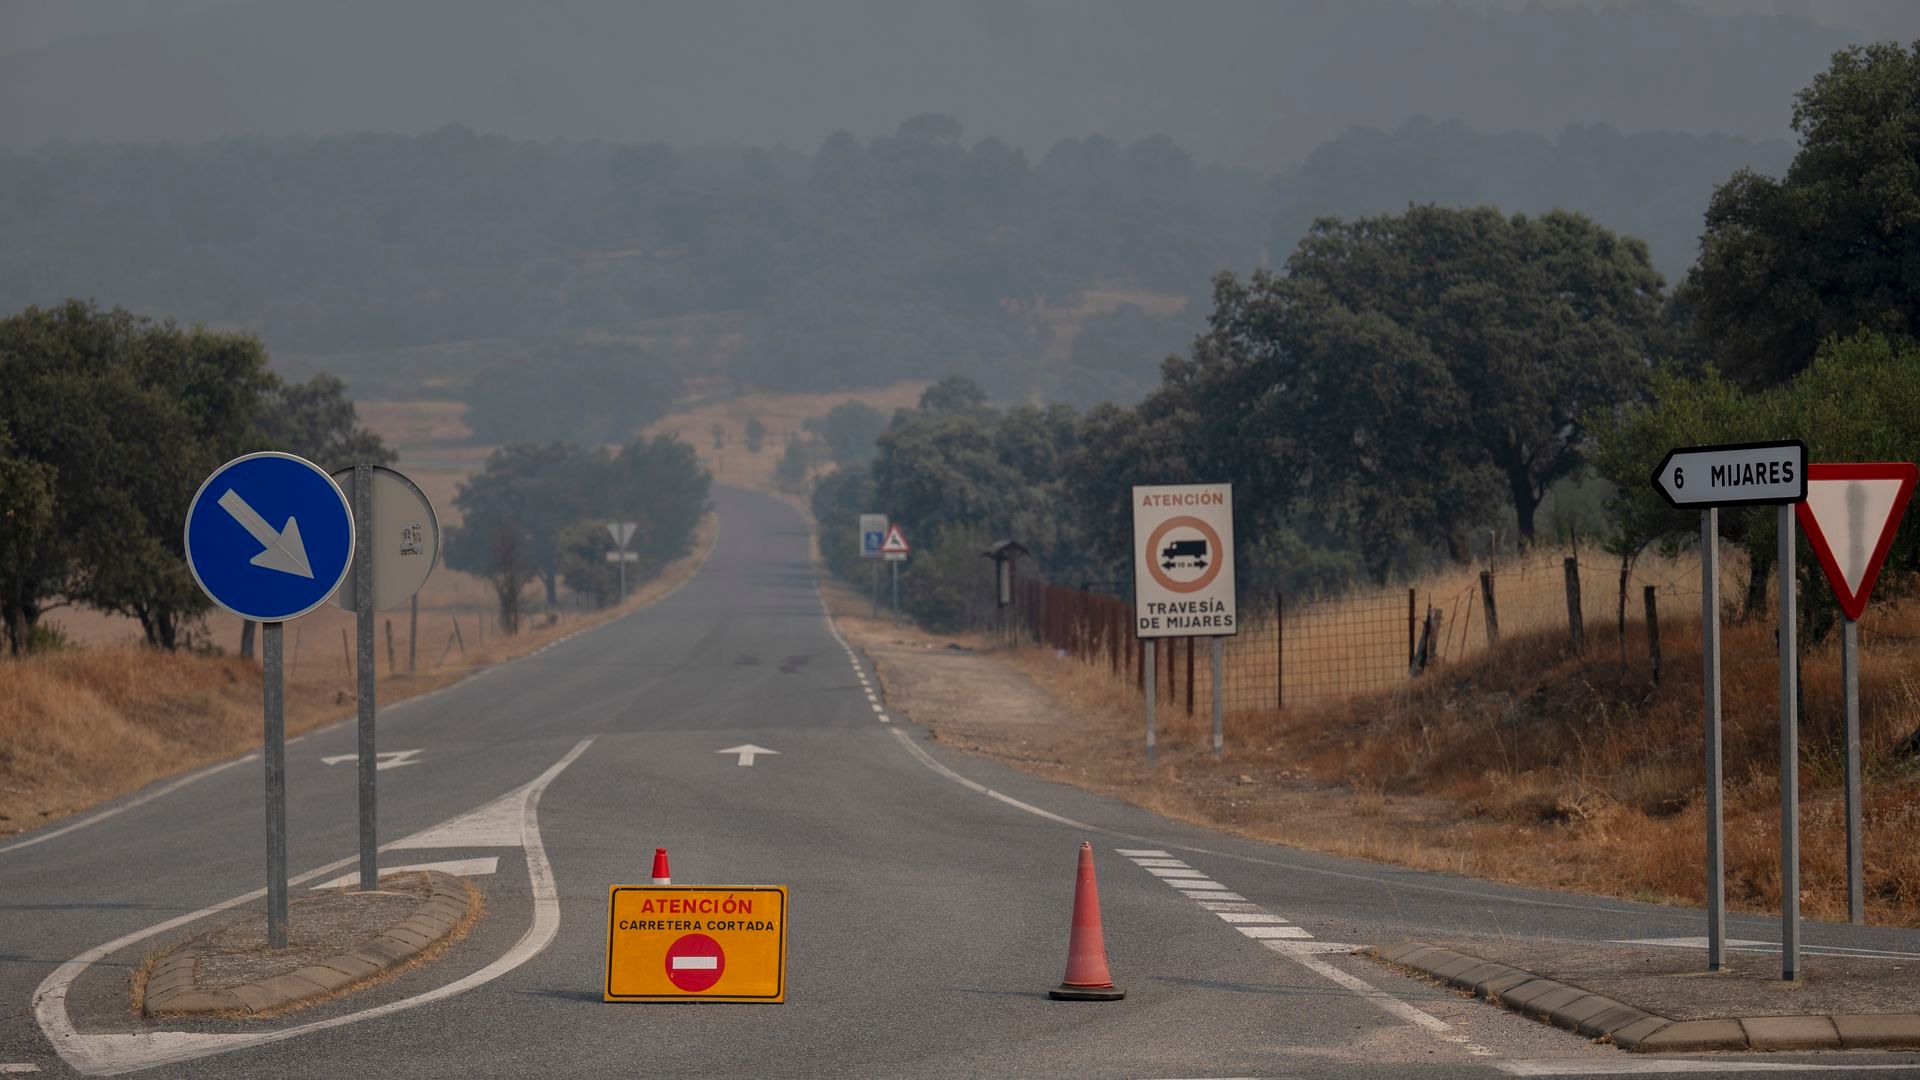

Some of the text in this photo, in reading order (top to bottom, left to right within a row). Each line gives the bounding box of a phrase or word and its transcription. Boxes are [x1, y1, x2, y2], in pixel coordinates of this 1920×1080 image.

[1673, 461, 1794, 489] 6 MIJARES
[1142, 489, 1224, 507] ATENCIÓN
[1147, 597, 1225, 615] TRAVESÍA
[1140, 615, 1233, 629] DE MIJARES
[641, 894, 753, 914] ATENCIÓN
[619, 920, 774, 931] CARRETERA CORTADA
